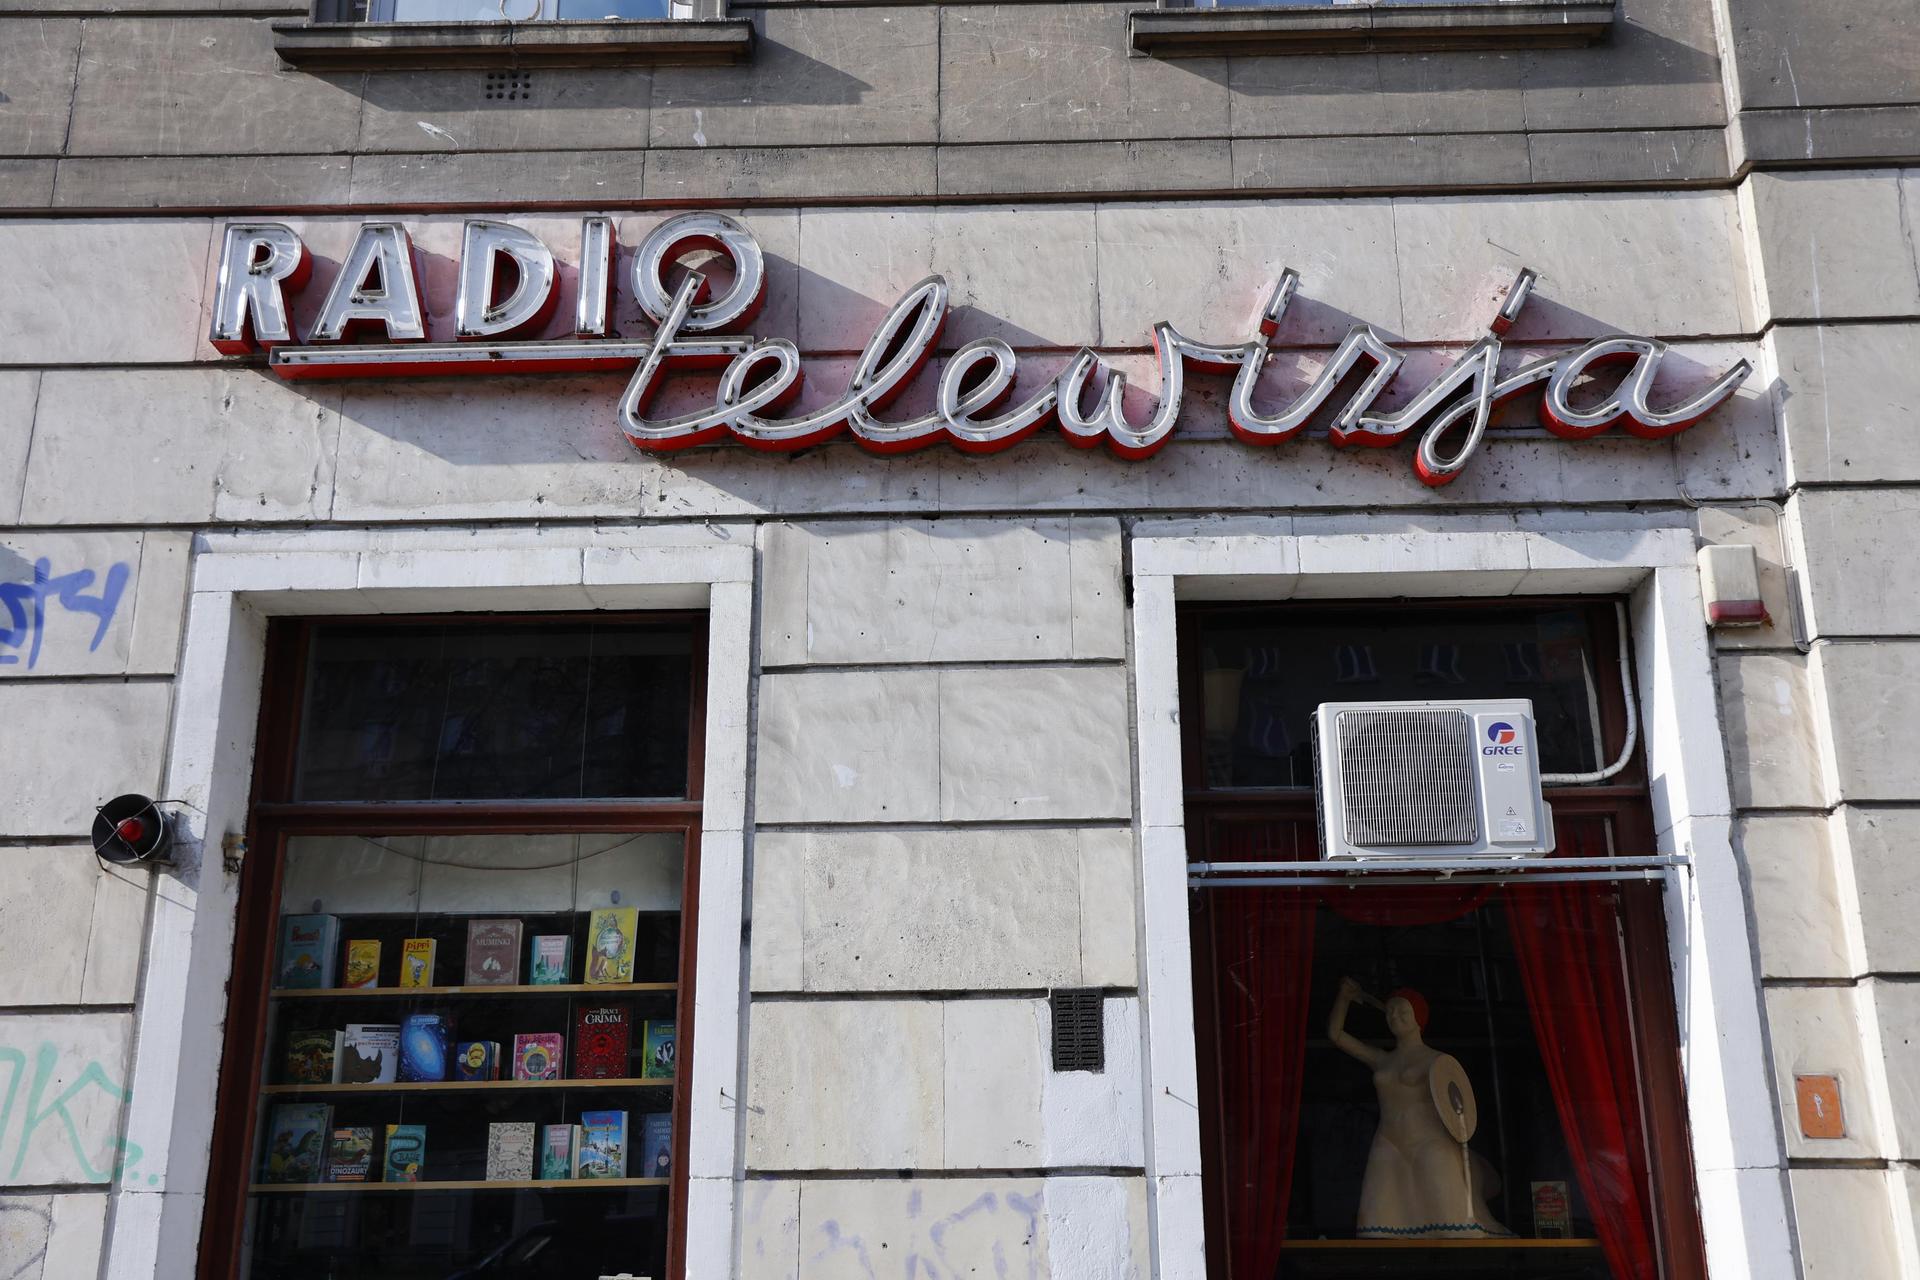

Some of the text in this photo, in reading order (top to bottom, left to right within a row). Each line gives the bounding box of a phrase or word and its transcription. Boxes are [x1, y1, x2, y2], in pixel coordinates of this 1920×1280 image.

[210, 212, 766, 353] RADIO
[1483, 745, 1523, 756] GREE
[476, 938, 511, 946] MUMINKI
[585, 1014, 622, 1025] GRIMM
